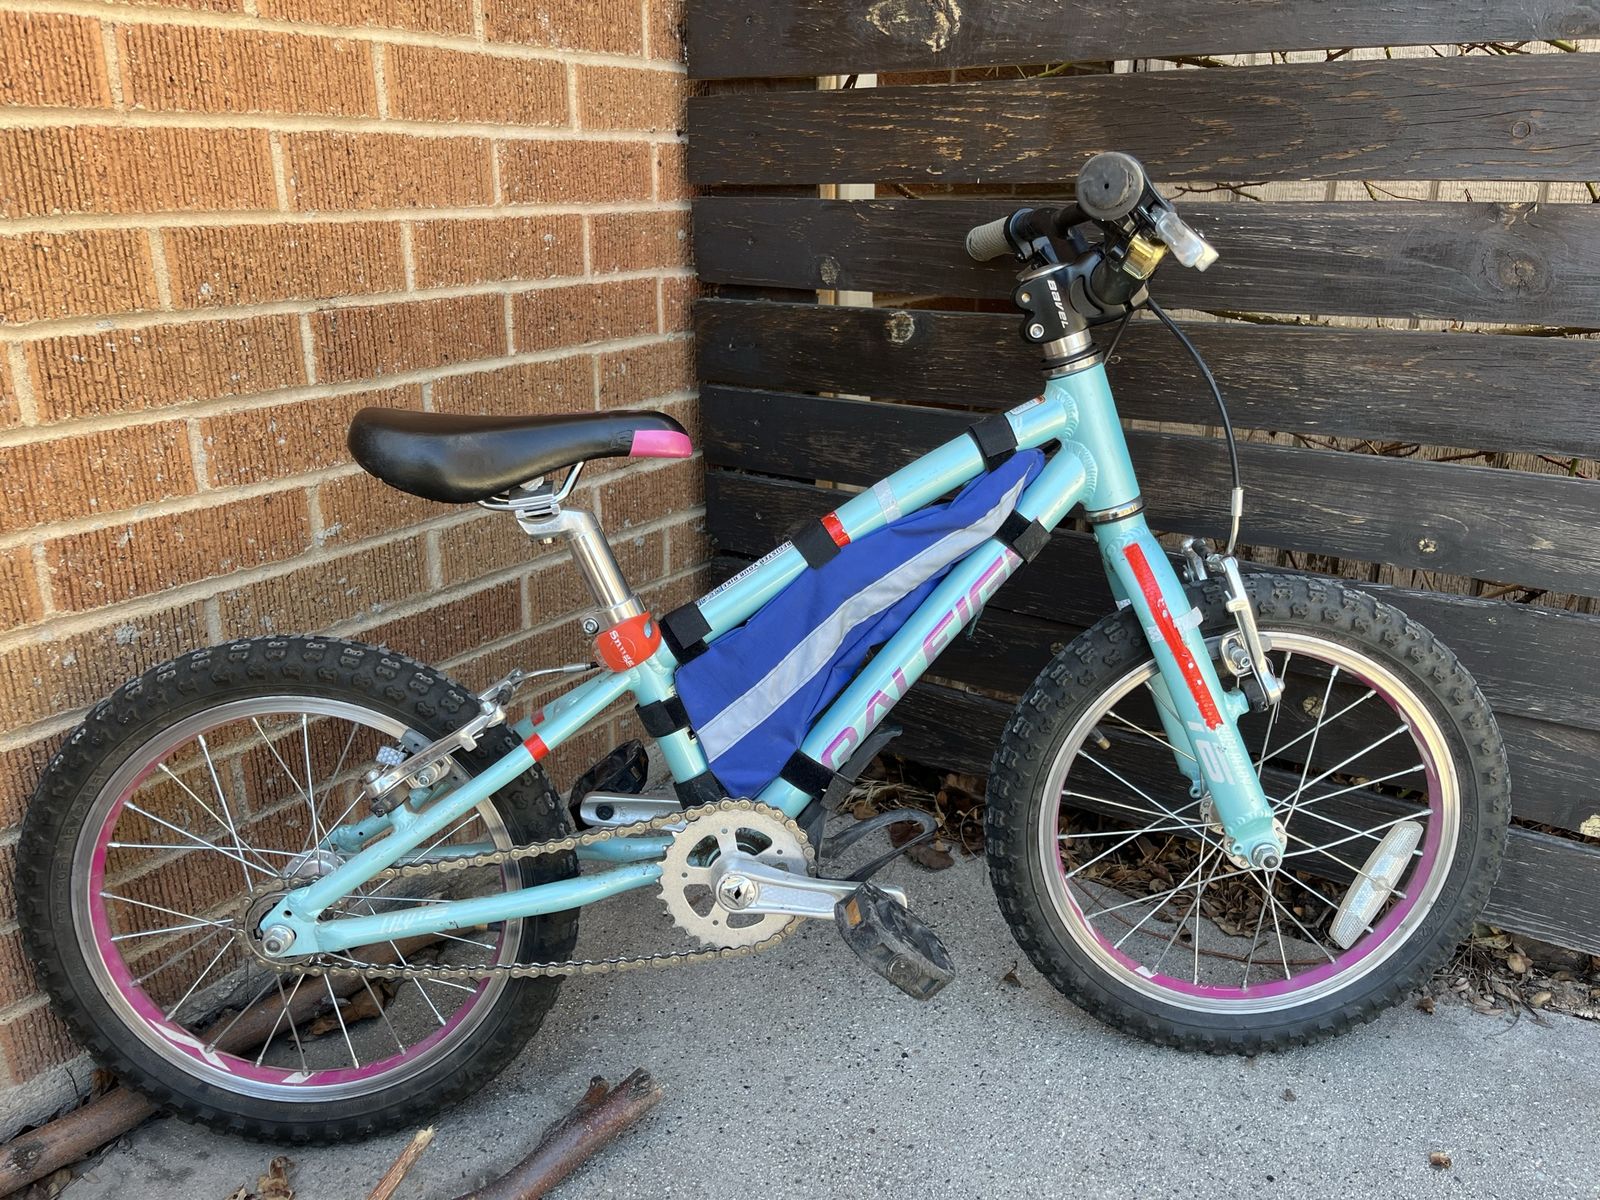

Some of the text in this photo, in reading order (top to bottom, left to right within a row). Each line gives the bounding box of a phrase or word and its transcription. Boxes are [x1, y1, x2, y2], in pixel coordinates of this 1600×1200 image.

[740, 563, 759, 579] YOUR
[821, 548, 1023, 769] RALEIG
[1187, 721, 1236, 785] 16
